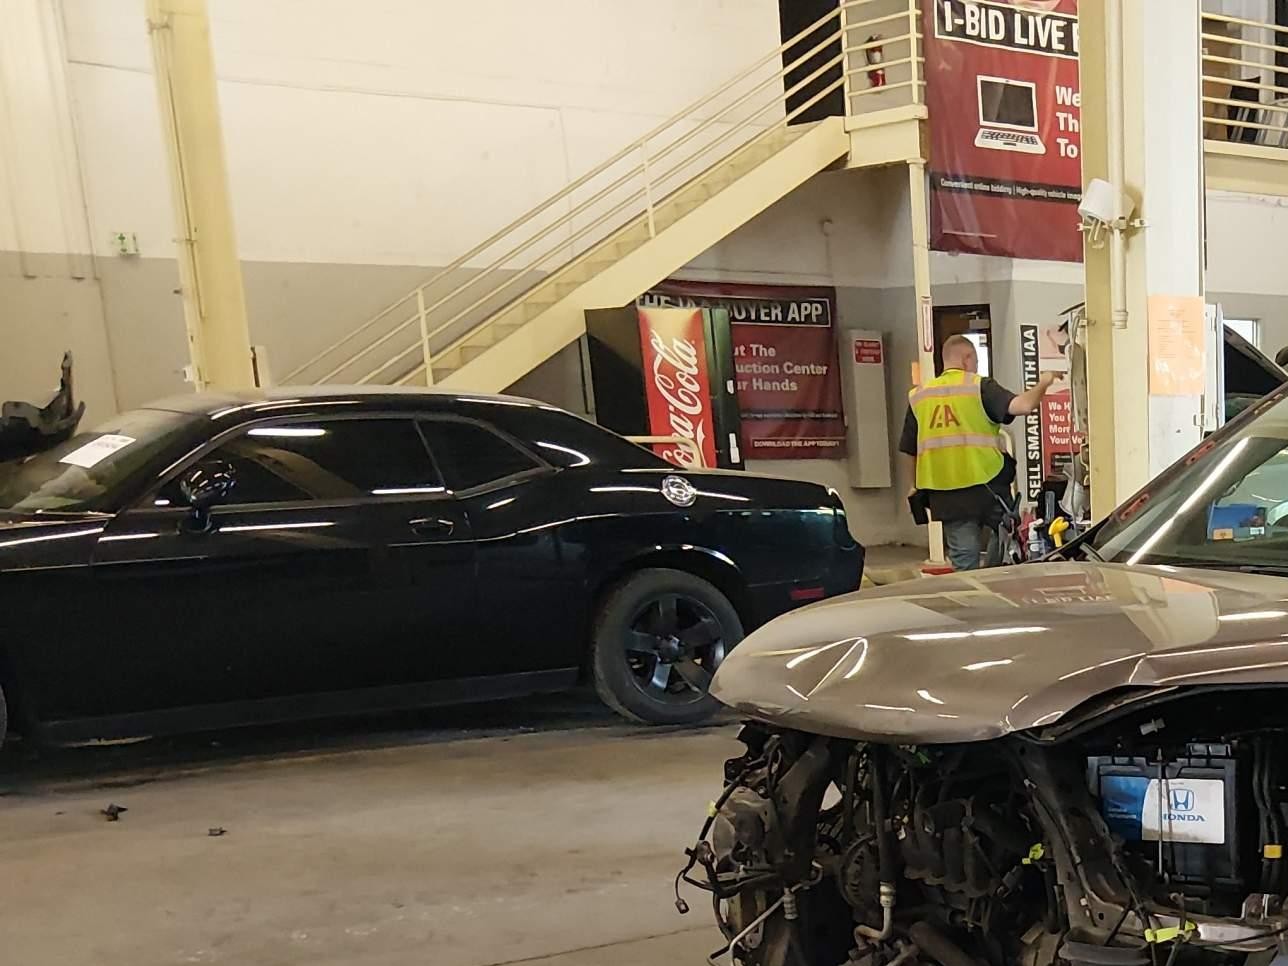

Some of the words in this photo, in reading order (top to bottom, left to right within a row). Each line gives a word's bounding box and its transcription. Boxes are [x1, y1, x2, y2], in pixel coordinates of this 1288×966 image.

[1014, 13, 1067, 50] LIVE
[1055, 85, 1080, 107] We
[1055, 111, 1079, 132] Th
[1056, 137, 1078, 158] To
[786, 302, 823, 323] APP
[749, 344, 776, 357] The
[1023, 329, 1037, 356] IAA
[735, 362, 780, 375] uction
[783, 362, 828, 375] Center
[1025, 360, 1037, 390] ITH
[752, 378, 798, 391] Hands
[1048, 402, 1062, 411] We
[1049, 413, 1065, 422] You
[1026, 407, 1040, 460] SMAR
[1049, 435, 1069, 445] Your
[1029, 463, 1041, 498] SELL
